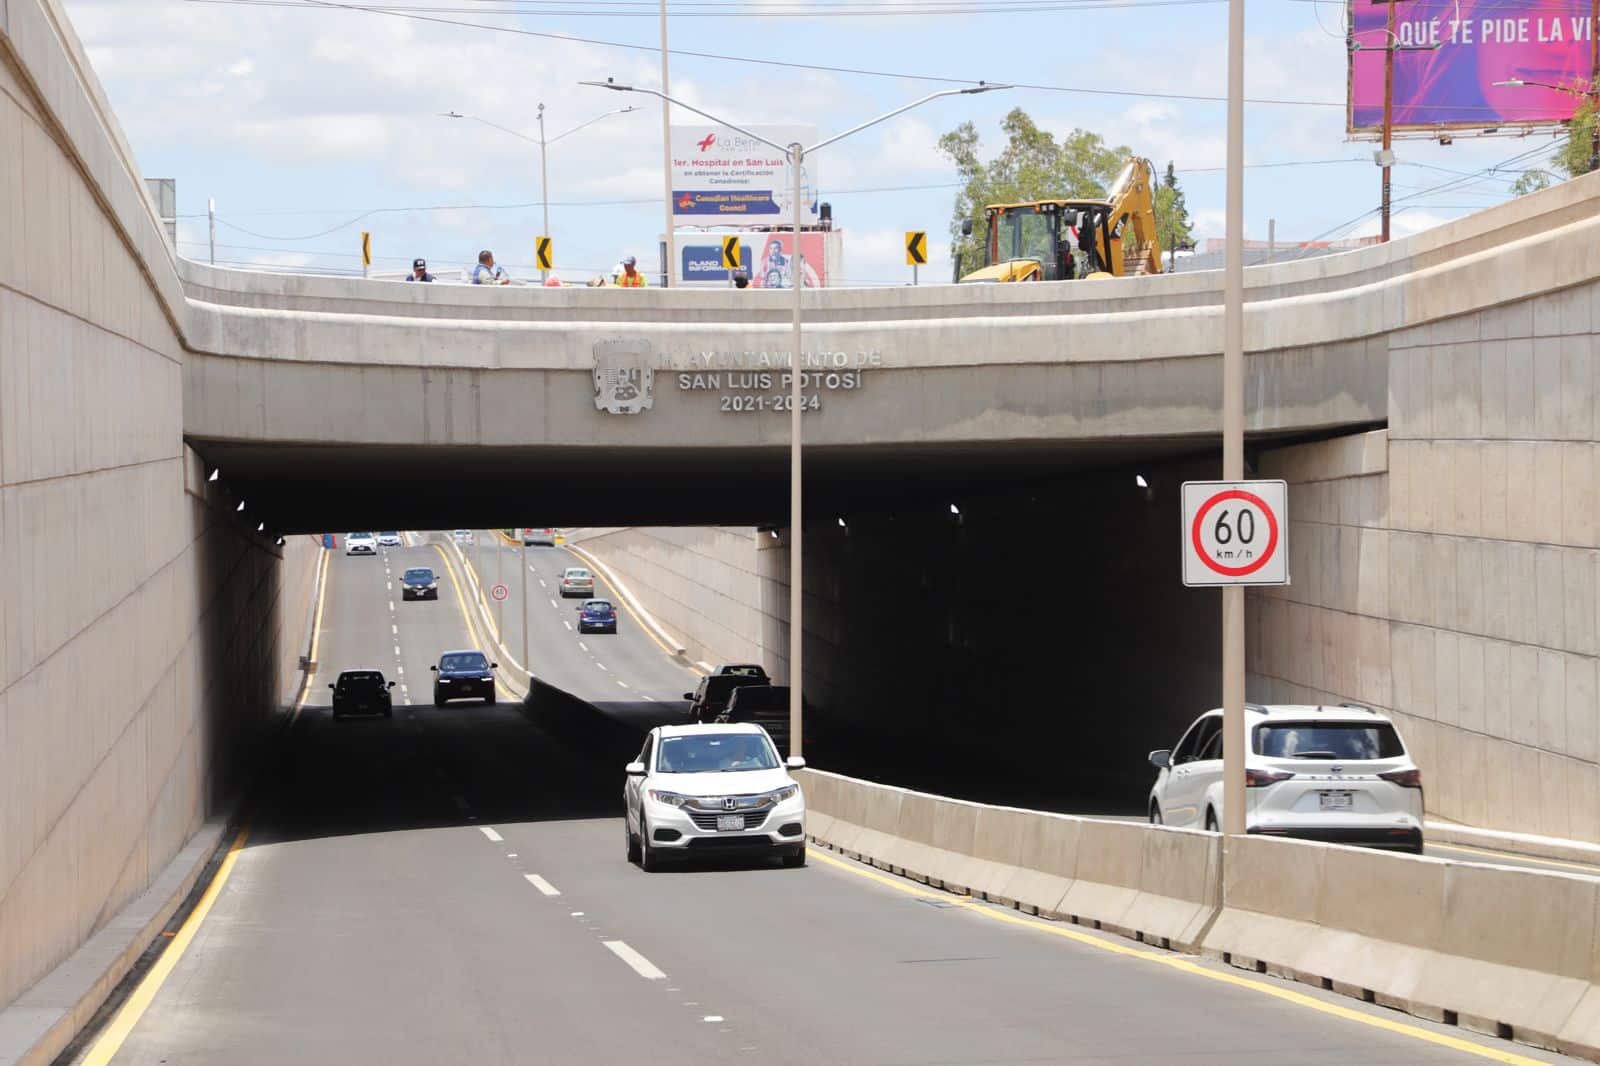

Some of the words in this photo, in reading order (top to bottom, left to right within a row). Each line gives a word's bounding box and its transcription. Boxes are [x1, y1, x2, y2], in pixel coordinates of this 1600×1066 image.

[1399, 16, 1441, 46] QUÉ
[1449, 20, 1473, 44] TE
[1481, 18, 1529, 43] PIDE
[1537, 17, 1563, 42] LA
[1571, 17, 1600, 41] VI
[673, 159, 689, 167] 1er.
[692, 159, 730, 168] Hospital
[746, 159, 763, 167] San
[765, 159, 784, 167] Luis
[855, 350, 881, 366] DE
[679, 374, 721, 390] SAN
[728, 372, 773, 389] LUIS
[781, 369, 863, 389] POTOSÍ
[720, 395, 821, 412] 2021-2024
[1214, 508, 1255, 544] 60
[1216, 549, 1253, 559] km/h
